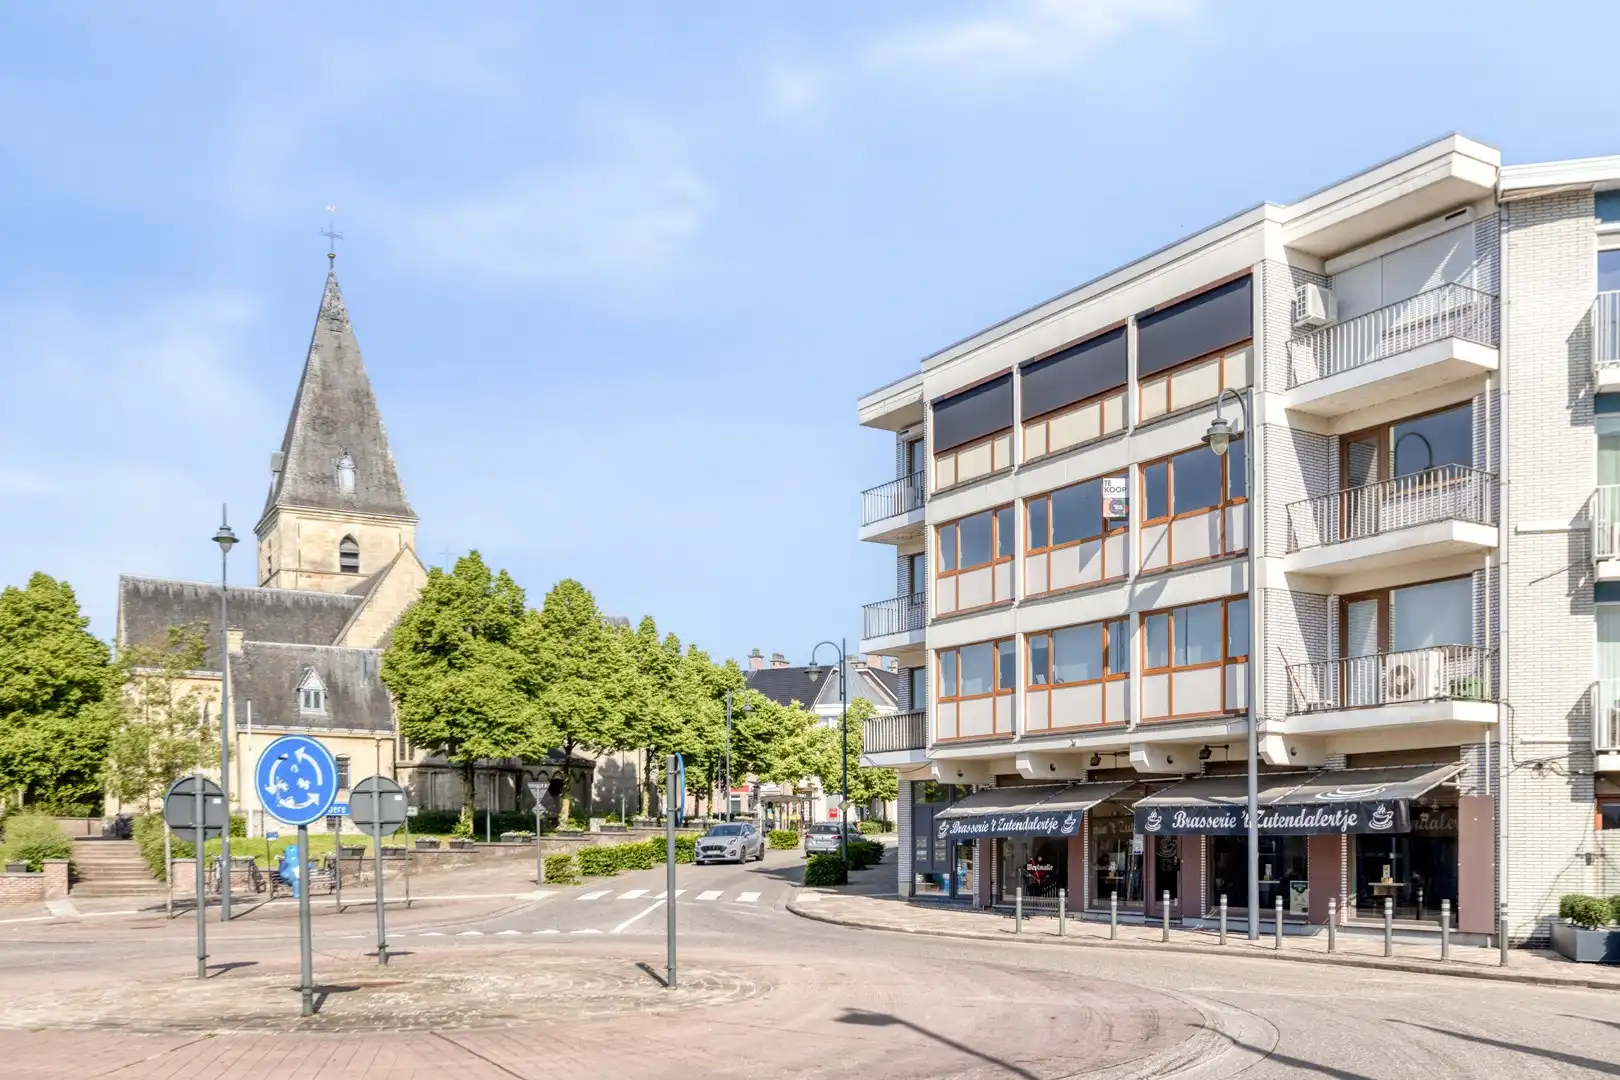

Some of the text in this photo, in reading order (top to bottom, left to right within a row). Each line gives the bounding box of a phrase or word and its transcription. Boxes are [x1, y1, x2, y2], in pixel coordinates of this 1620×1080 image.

[949, 815, 1058, 835] Brasserie 't Zutendalertje
[1172, 810, 1237, 829] Brasserie
[1026, 863, 1054, 872] Westmalle
